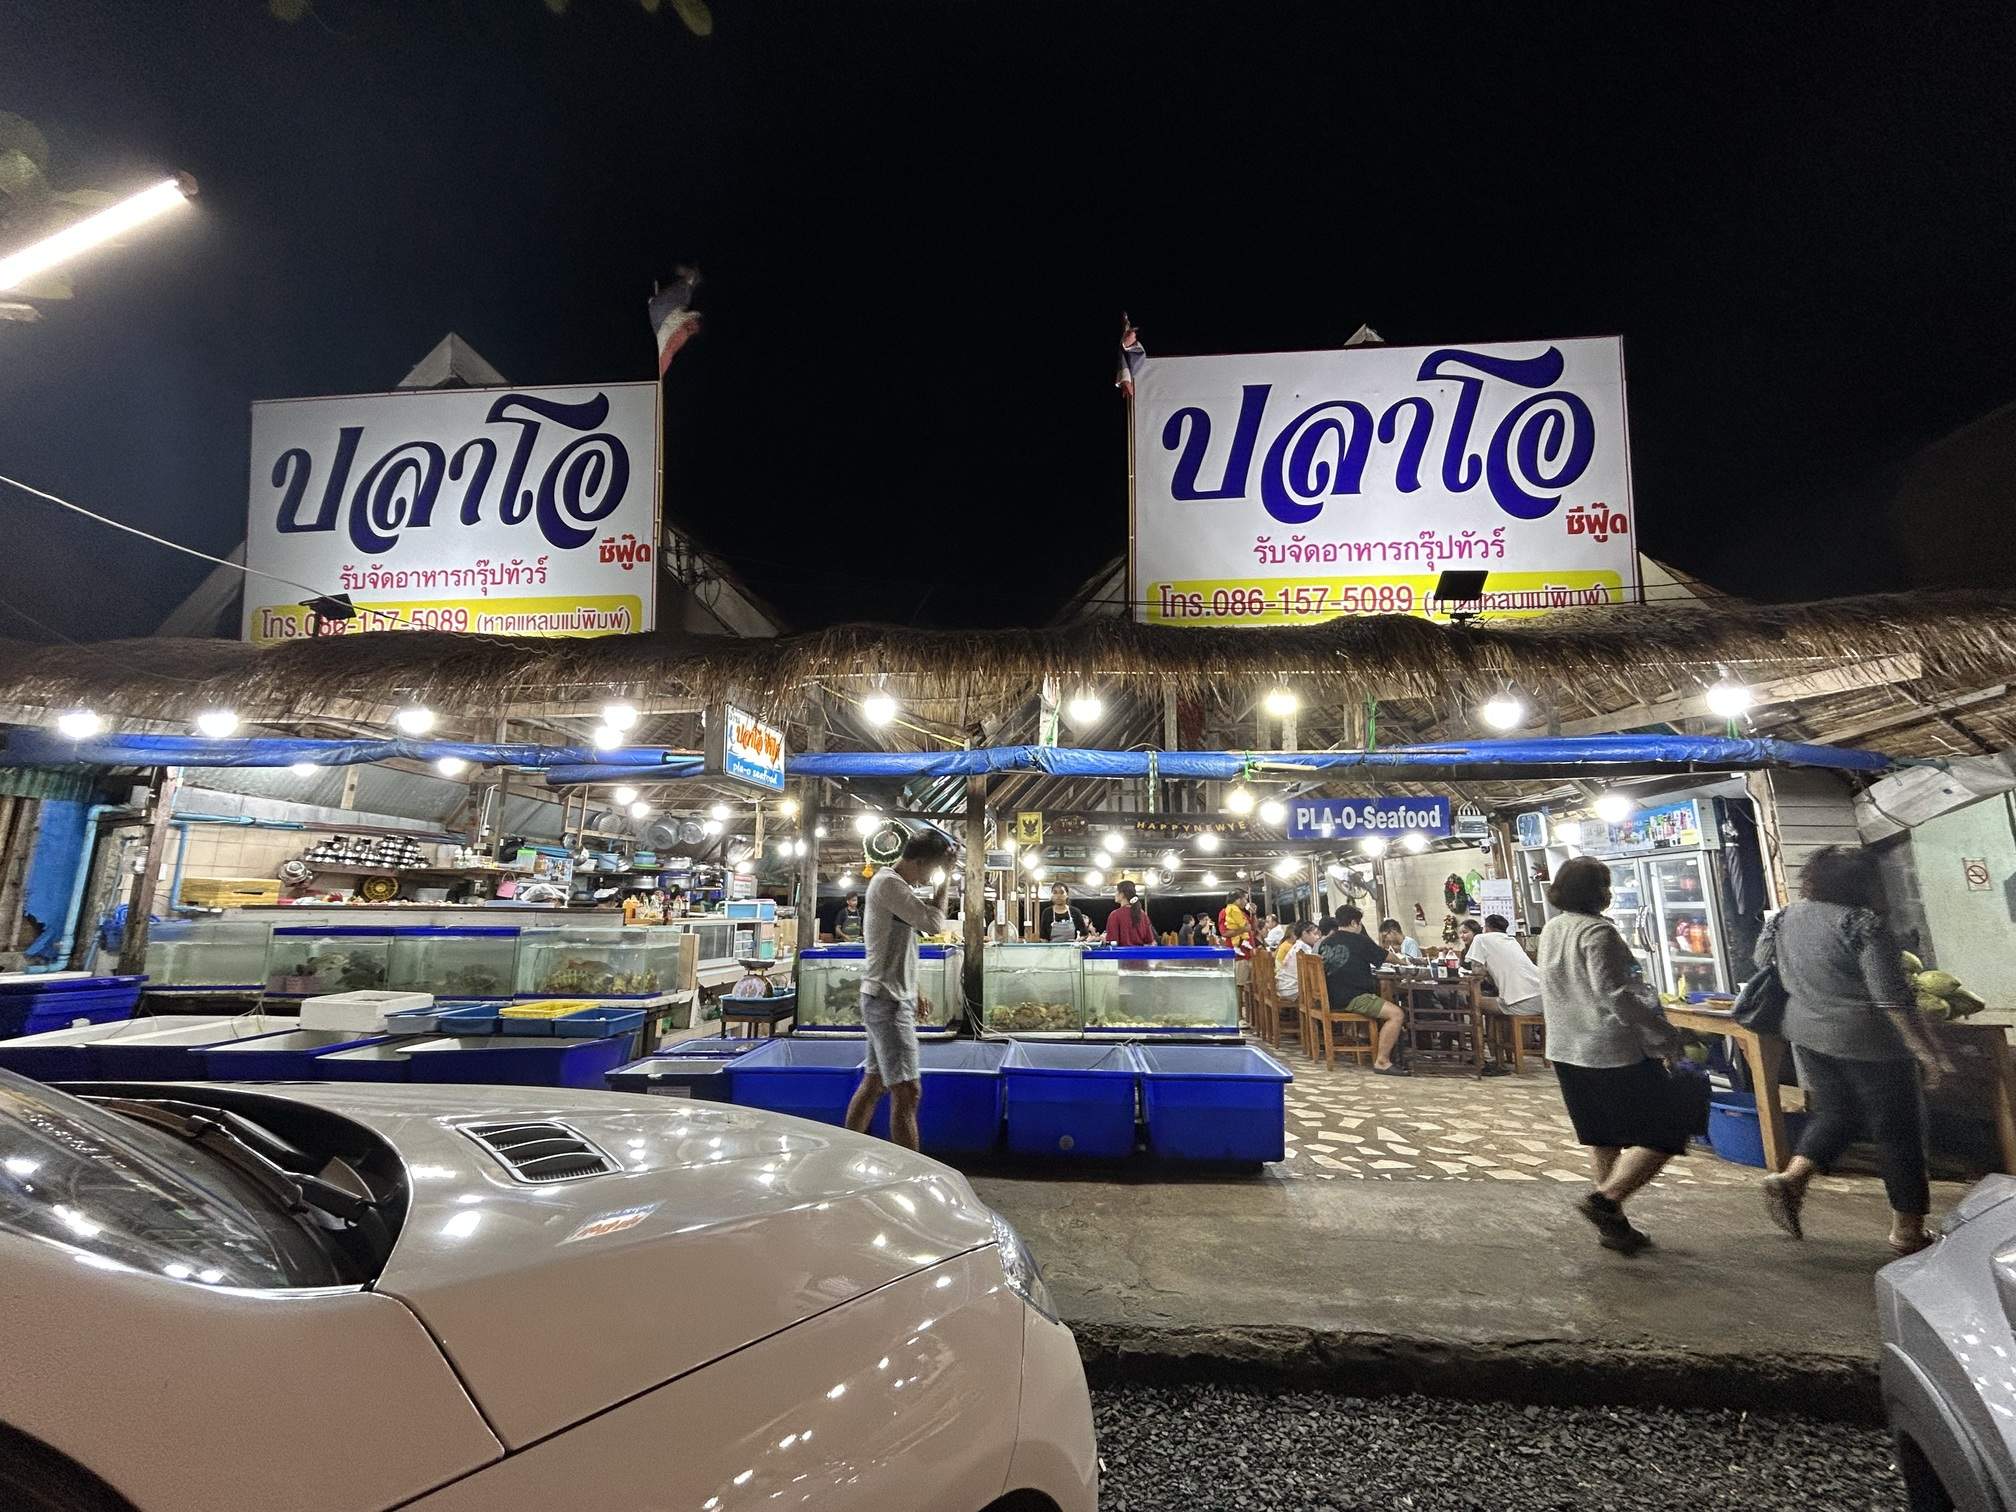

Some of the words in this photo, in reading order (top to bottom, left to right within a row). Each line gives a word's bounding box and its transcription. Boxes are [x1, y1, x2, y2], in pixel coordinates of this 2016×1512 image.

[1162, 346, 1596, 524] ปลาโอ
[271, 392, 630, 554] ปลาโอ
[1253, 526, 1506, 571] รับจัดอาหารกรุ๊ปทัวร์
[339, 555, 549, 596] รับจัดอาหารกรุ๊ปทัวร์
[1296, 805, 1441, 830] PLA-O-Seafood
